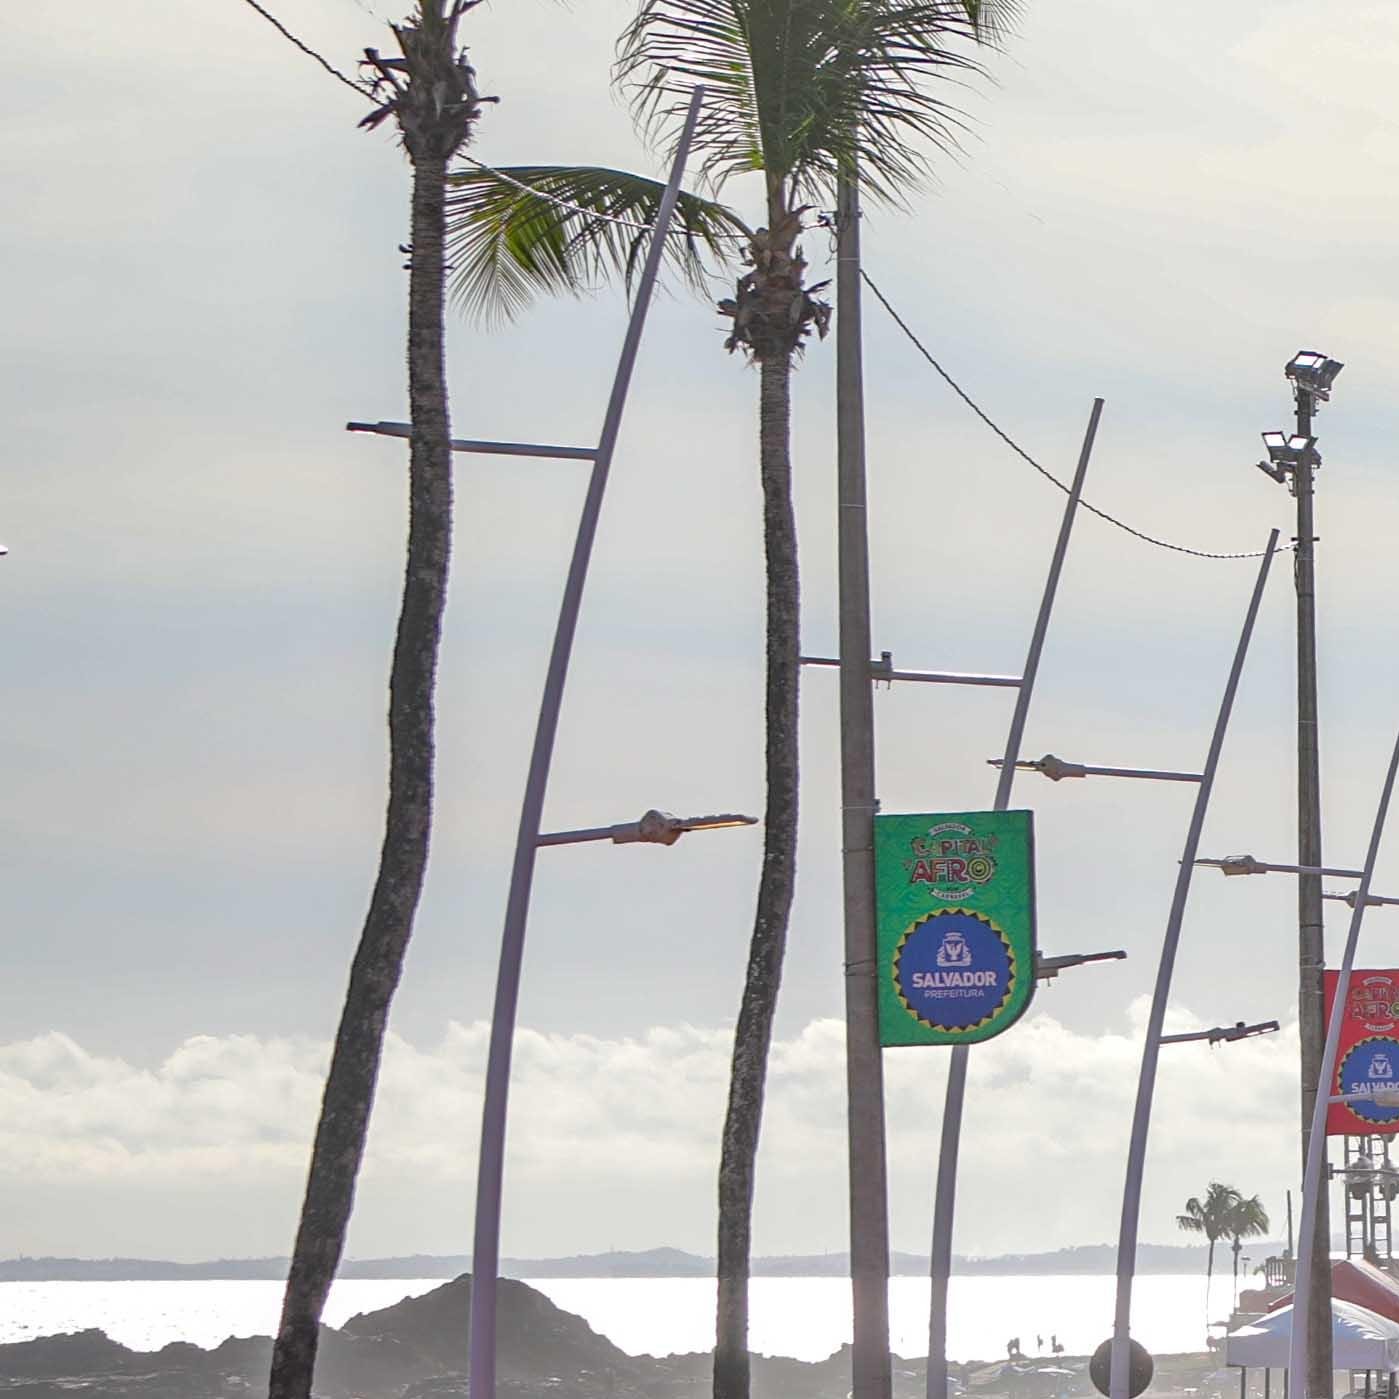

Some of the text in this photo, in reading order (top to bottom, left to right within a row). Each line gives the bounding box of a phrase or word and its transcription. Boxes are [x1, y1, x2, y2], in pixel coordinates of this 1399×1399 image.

[912, 836, 998, 855] CAPITAL
[910, 856, 995, 885] AFRO
[912, 972, 997, 988] SALVADOR
[924, 989, 984, 999] PREFEITURA
